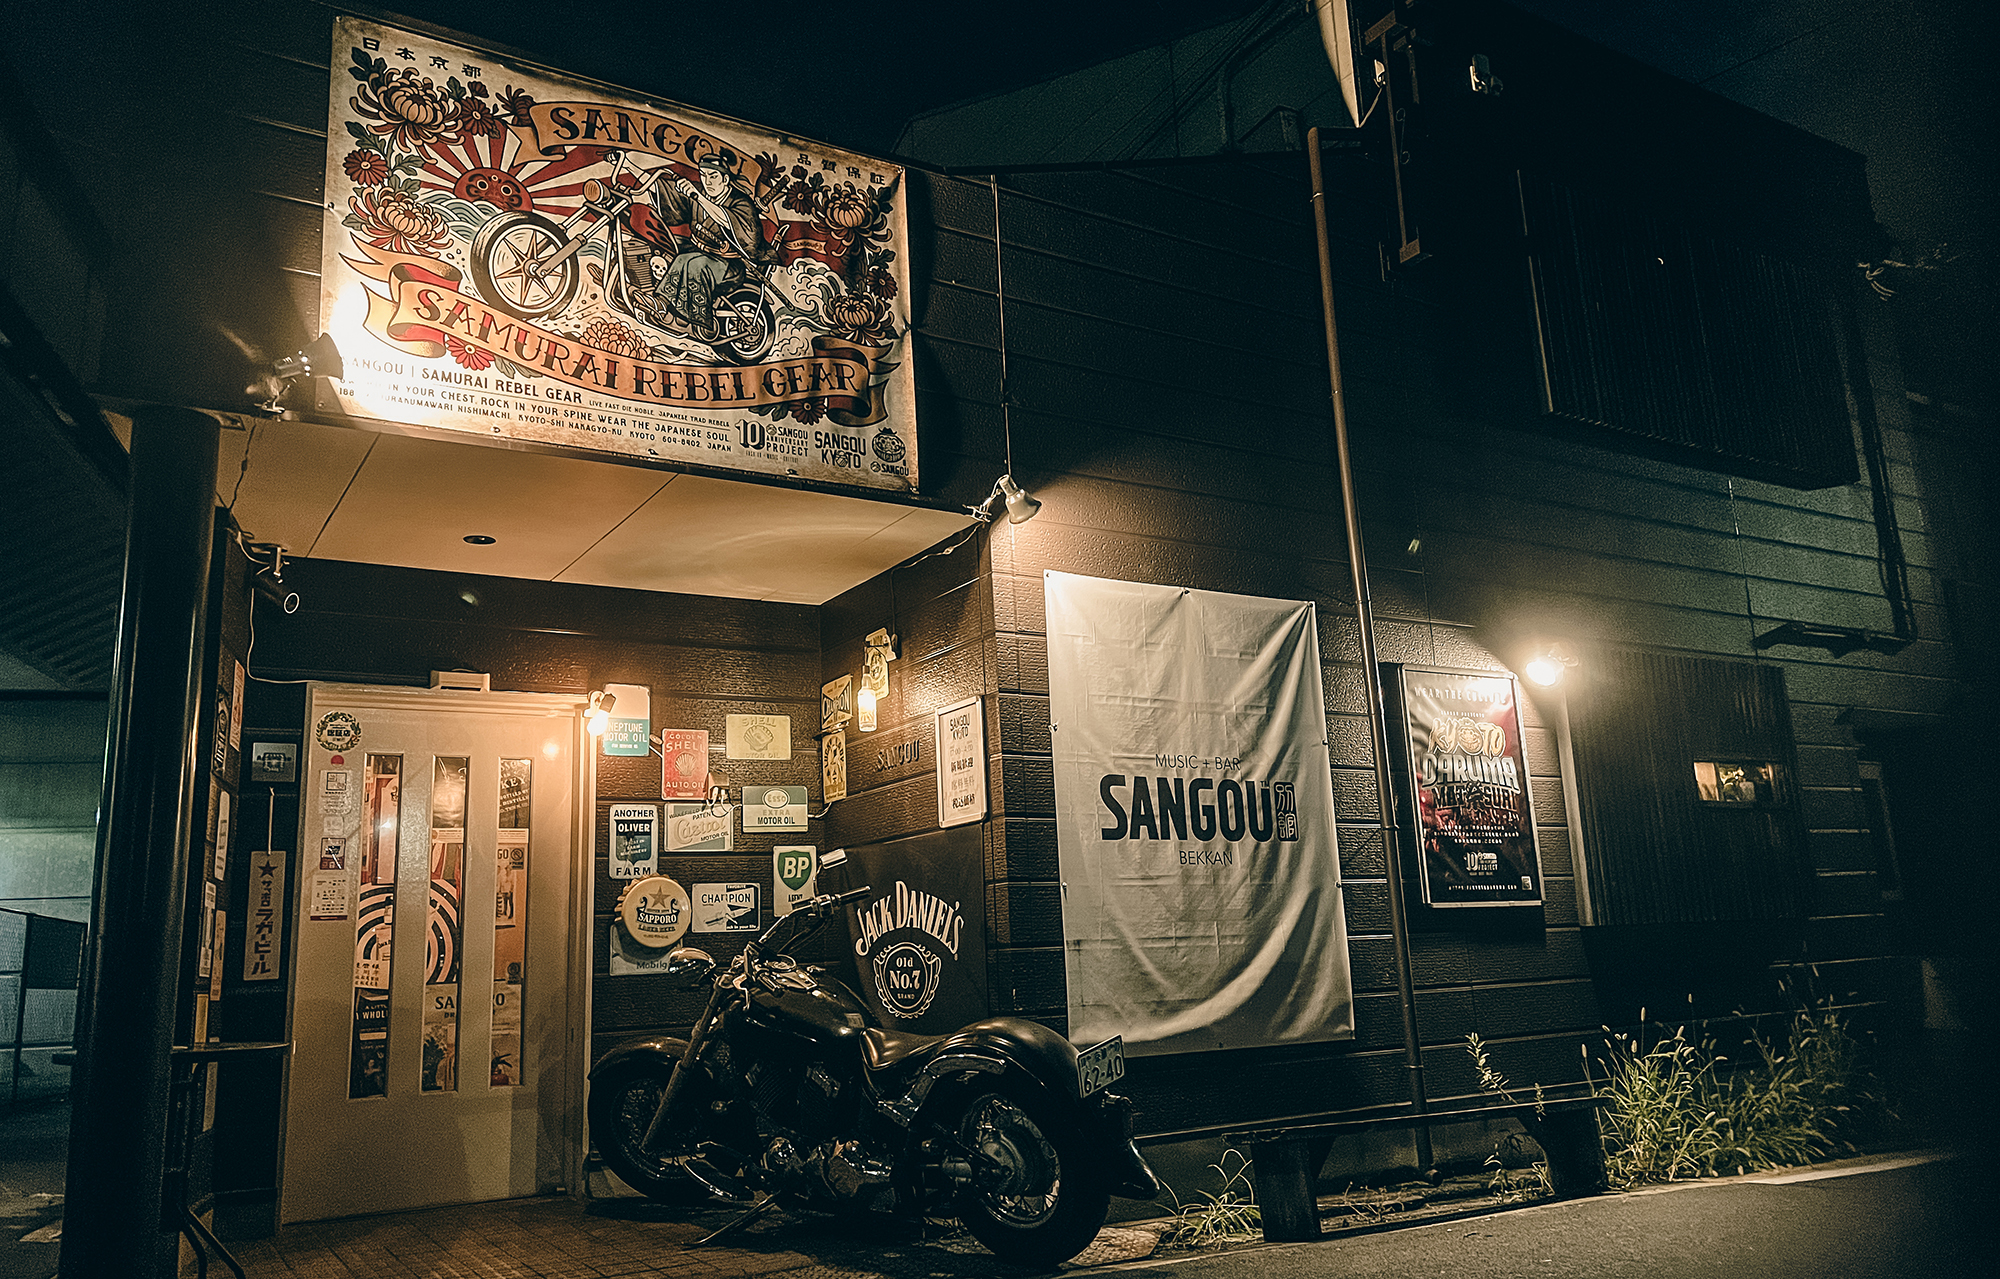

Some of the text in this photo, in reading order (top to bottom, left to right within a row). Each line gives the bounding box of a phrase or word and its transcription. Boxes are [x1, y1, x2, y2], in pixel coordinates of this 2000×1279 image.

[363, 37, 482, 79] 日本京都
[413, 288, 861, 402] SAMURAI REBEL GEAR
[343, 356, 404, 375] ANGOU
[422, 368, 488, 389] SAMURAI
[495, 379, 538, 397] REBEL
[546, 387, 582, 404] GEAR
[406, 385, 435, 398] YOUR
[481, 396, 510, 409] ROCK
[515, 402, 526, 412] IN
[531, 404, 558, 416] YOUR
[598, 414, 627, 427] WEAR
[632, 420, 650, 431] THE
[655, 423, 702, 439] JAPANESE
[518, 414, 564, 428] KYOTO-SHI
[707, 442, 732, 452] JAPAN
[735, 419, 808, 450] 10 SANGOU
[766, 434, 808, 447] ANNIVERSARY
[814, 431, 867, 456] SANGOU
[766, 443, 809, 457] PROJECT
[881, 464, 909, 476] SANGOU
[1414, 686, 1440, 698] WEAR
[1445, 689, 1462, 700] THE
[609, 722, 643, 733] NEPTUNE
[742, 717, 776, 728] SHELL
[633, 733, 647, 743] OIL
[665, 740, 706, 754] SHELL
[1155, 753, 1199, 769] MUSIC
[1215, 757, 1241, 771] BAR
[1422, 753, 1520, 794] DARUMA
[767, 794, 786, 803] Esso
[614, 809, 654, 817] ANOTHER
[1099, 774, 1274, 842] SANGOU
[693, 812, 712, 820] PATEN
[758, 816, 795, 825] MOTOR OIL
[618, 823, 651, 832] OLIVER
[673, 817, 726, 845] Castrol
[701, 833, 720, 842] MOTOR
[1179, 851, 1233, 867] BEKKAN
[616, 867, 651, 876] FARM
[783, 856, 810, 879] BP
[638, 912, 677, 924] SAPPORO
[855, 880, 964, 956] JACK DANIEL'S
[637, 961, 668, 971] Mobilg
[896, 957, 913, 967] Old
[1085, 1055, 1122, 1094] 62-40
